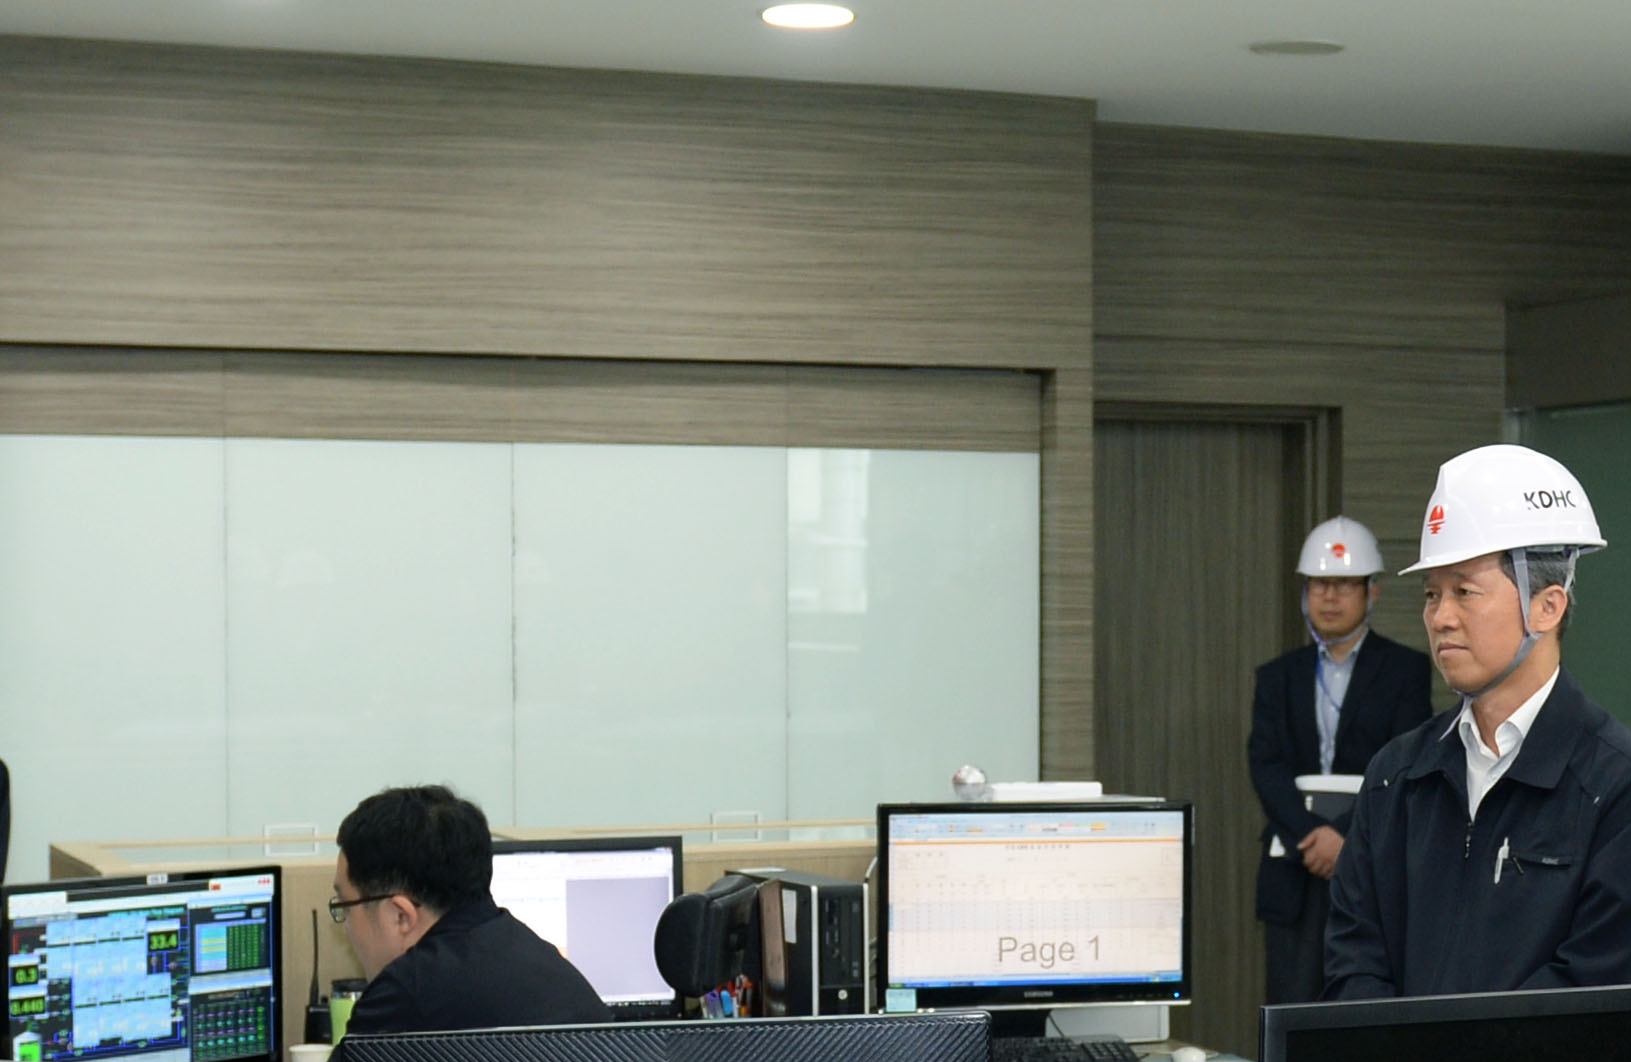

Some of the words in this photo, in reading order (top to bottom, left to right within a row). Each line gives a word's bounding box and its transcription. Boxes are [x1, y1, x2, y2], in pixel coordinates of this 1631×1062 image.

[1523, 489, 1577, 510] KDHC
[998, 936, 1075, 969] Page
[1088, 935, 1101, 961] 1
